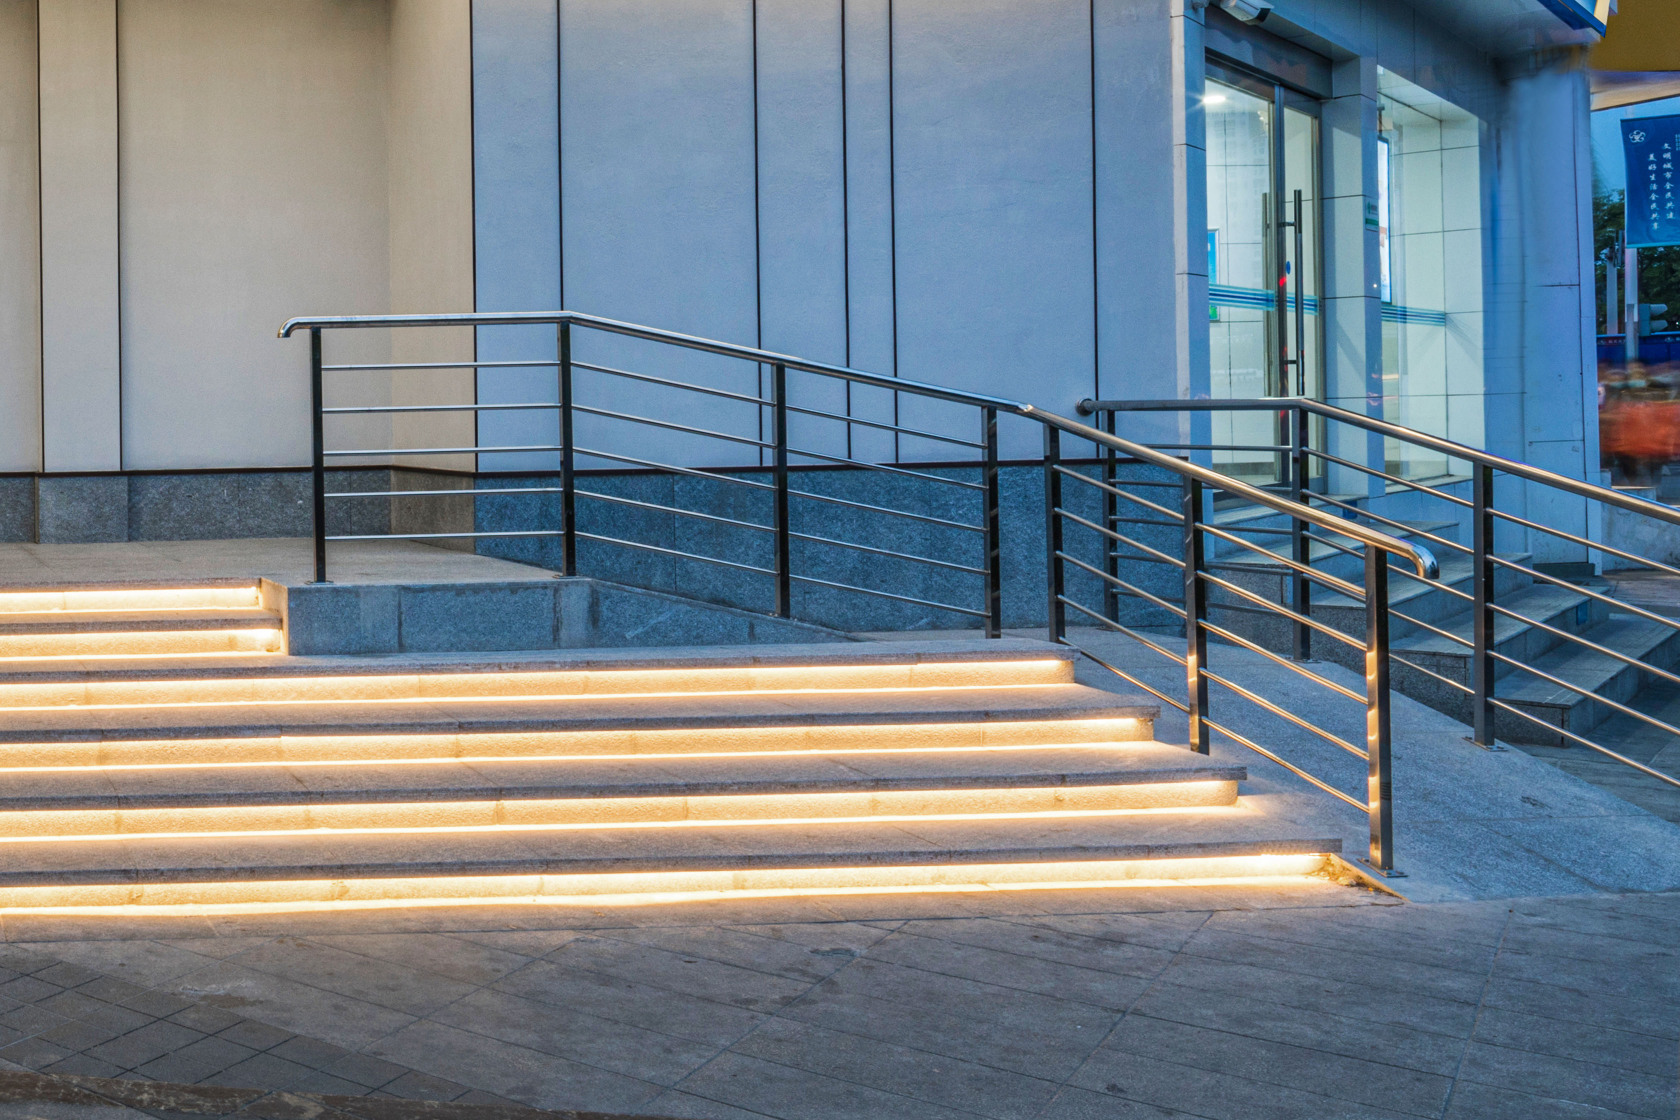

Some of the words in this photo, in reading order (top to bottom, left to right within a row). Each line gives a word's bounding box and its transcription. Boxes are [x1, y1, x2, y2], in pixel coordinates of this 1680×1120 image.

[1648, 153, 1659, 230] 美好生活全民共享
[1662, 143, 1674, 219] 文明城市全民共建
